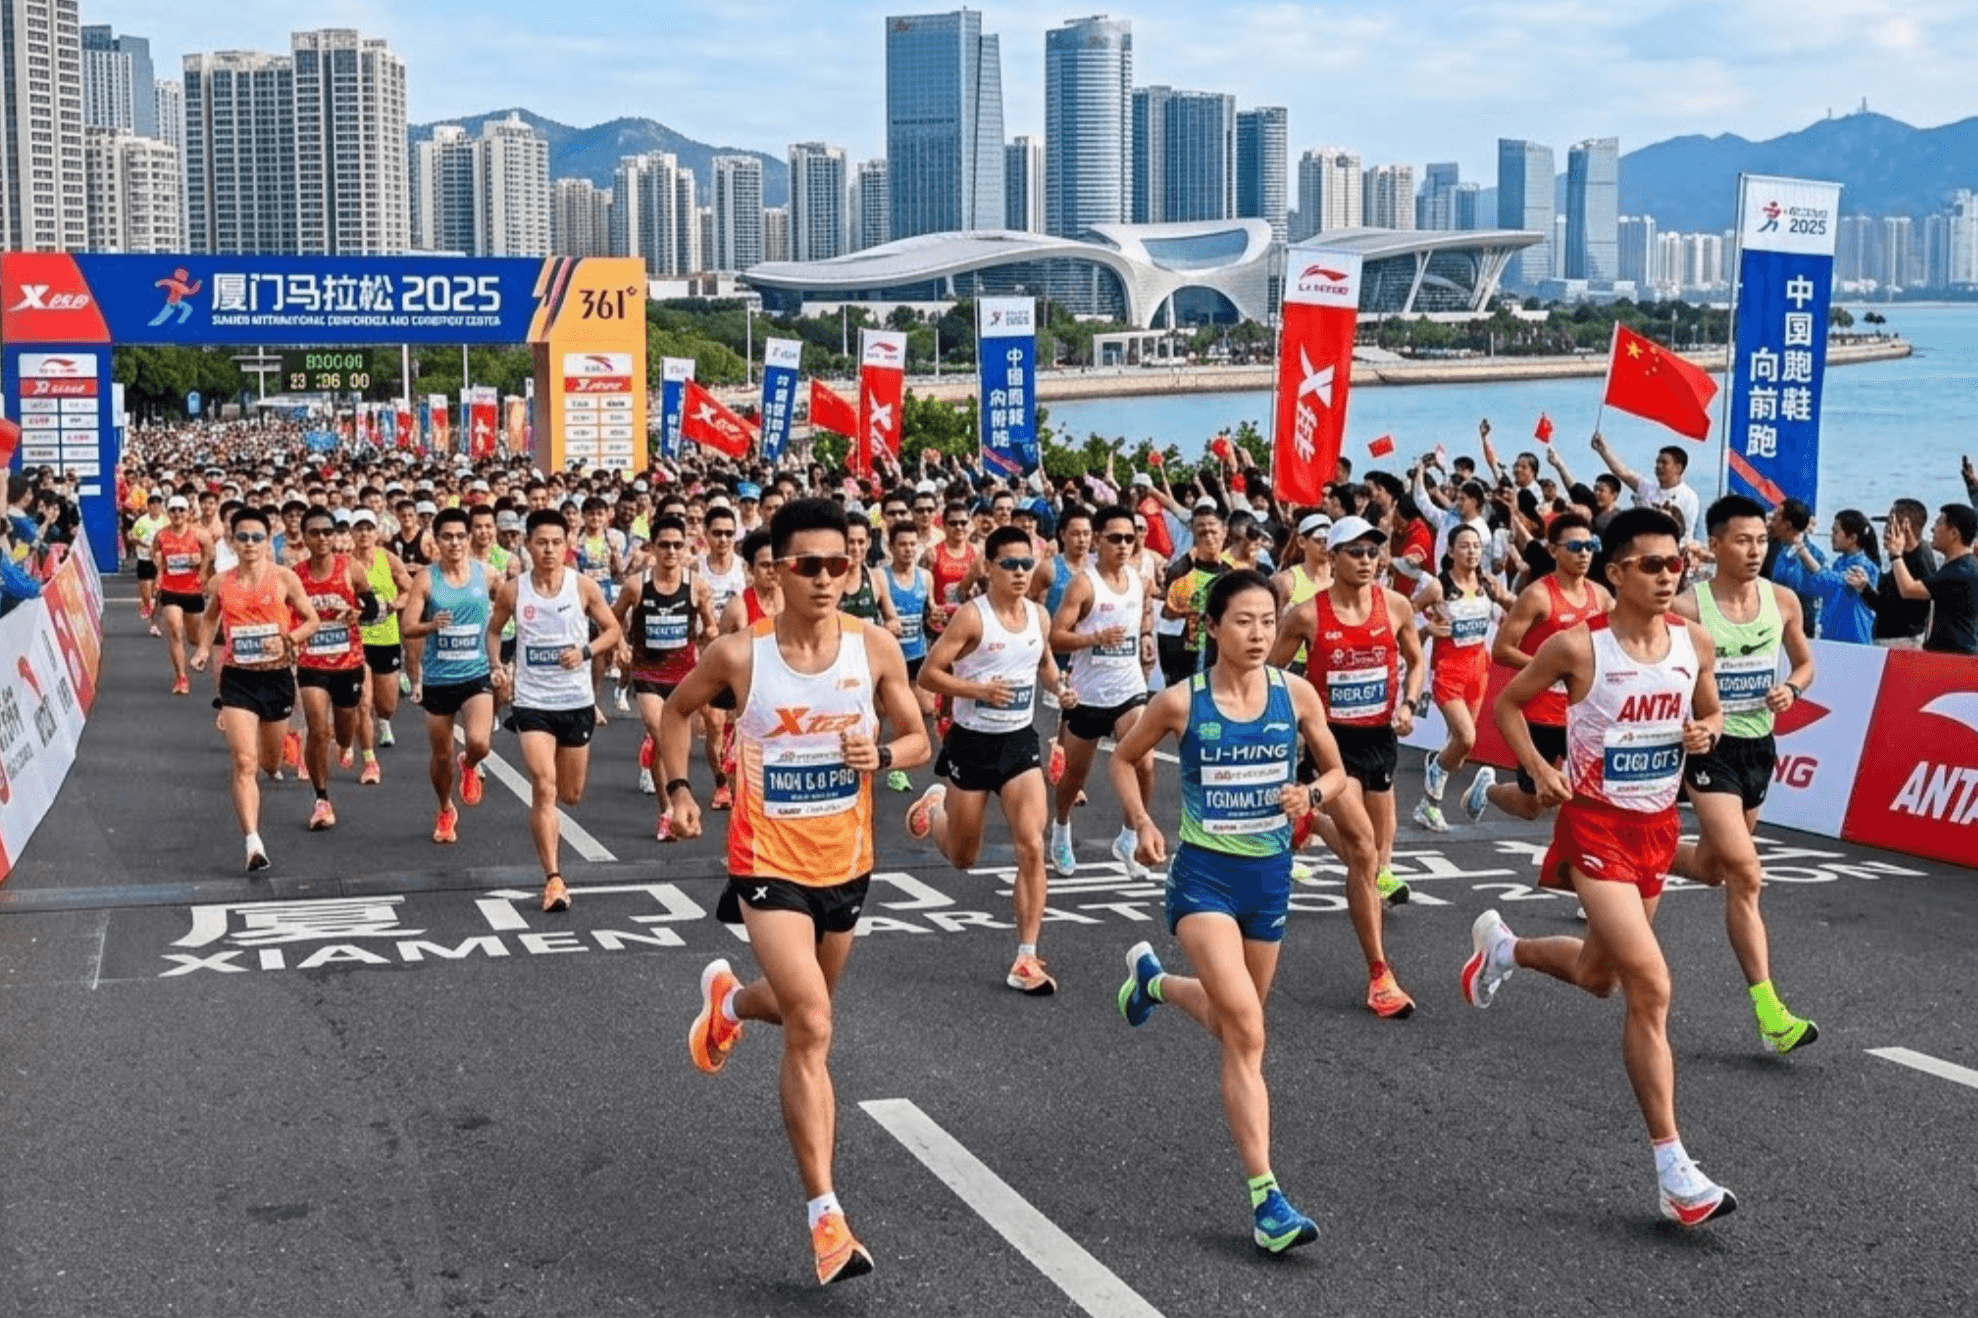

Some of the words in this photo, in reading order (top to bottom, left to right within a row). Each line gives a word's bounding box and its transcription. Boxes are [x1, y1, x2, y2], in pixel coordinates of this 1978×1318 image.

[1789, 218, 1827, 235] 2025
[401, 276, 501, 311] 2025
[1616, 692, 1682, 722] ANTA
[1775, 754, 1819, 788] NG
[158, 926, 687, 977] XIAMEN
